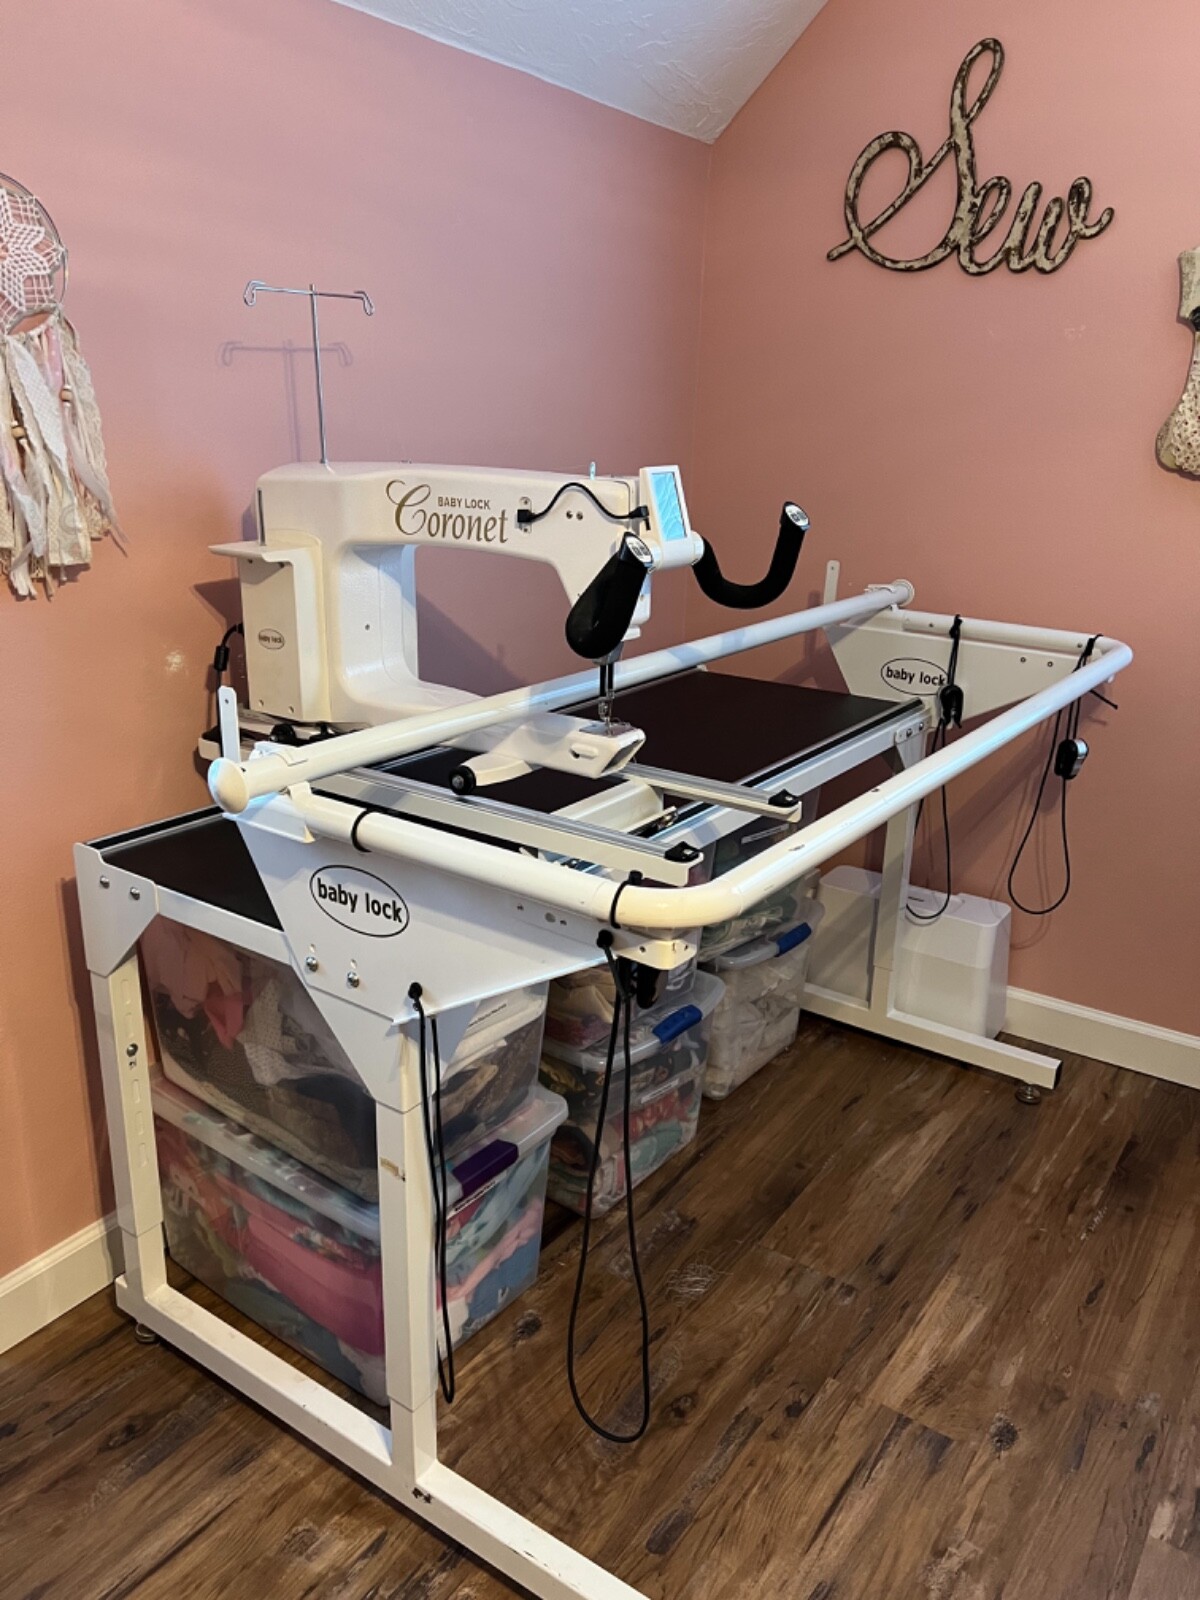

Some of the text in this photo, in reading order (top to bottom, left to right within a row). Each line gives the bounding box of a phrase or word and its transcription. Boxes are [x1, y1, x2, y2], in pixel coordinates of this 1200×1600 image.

[826, 37, 1114, 276] Sew
[386, 479, 508, 543] Coronet
[437, 496, 490, 510] BABY LOCK
[885, 666, 946, 686] baby lock
[317, 877, 402, 923] baby lock
